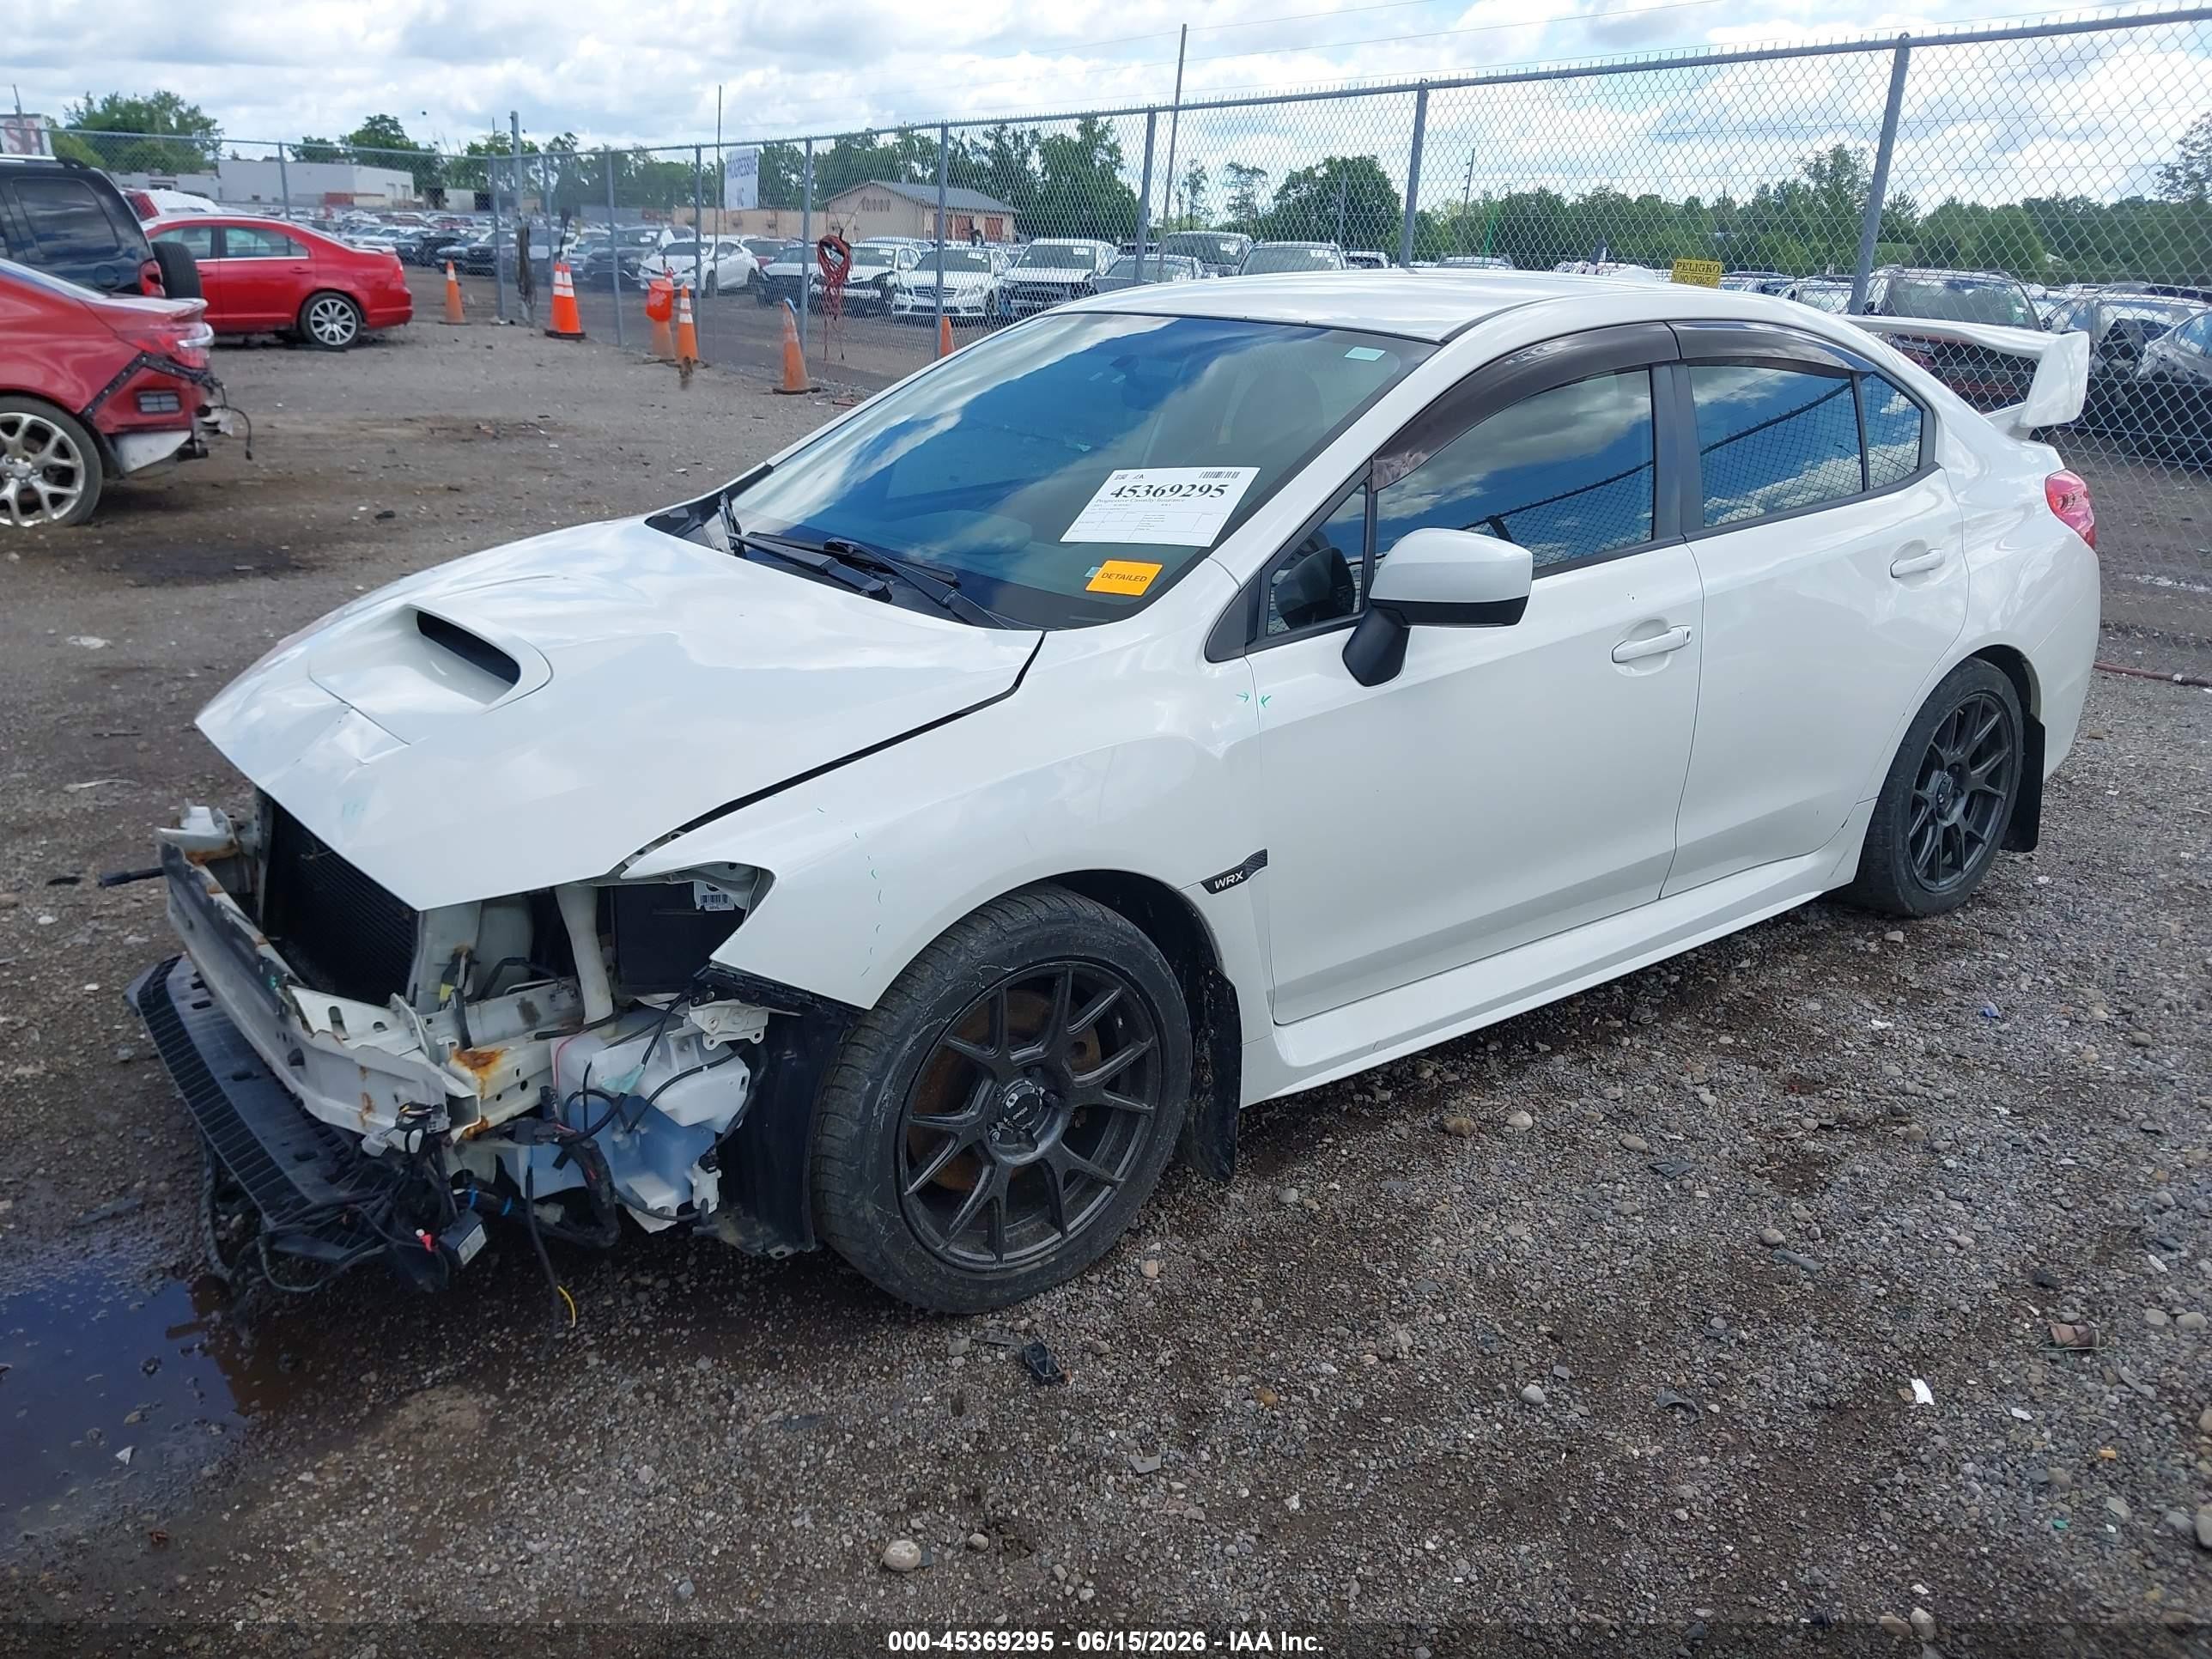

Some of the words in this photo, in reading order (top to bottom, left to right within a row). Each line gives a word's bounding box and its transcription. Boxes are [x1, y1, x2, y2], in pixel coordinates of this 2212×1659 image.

[1676, 261, 1720, 274] PELIGRO
[1110, 483, 1230, 498] 45369295
[1102, 573, 1147, 582] DETAILED
[1214, 871, 1243, 890] WRX
